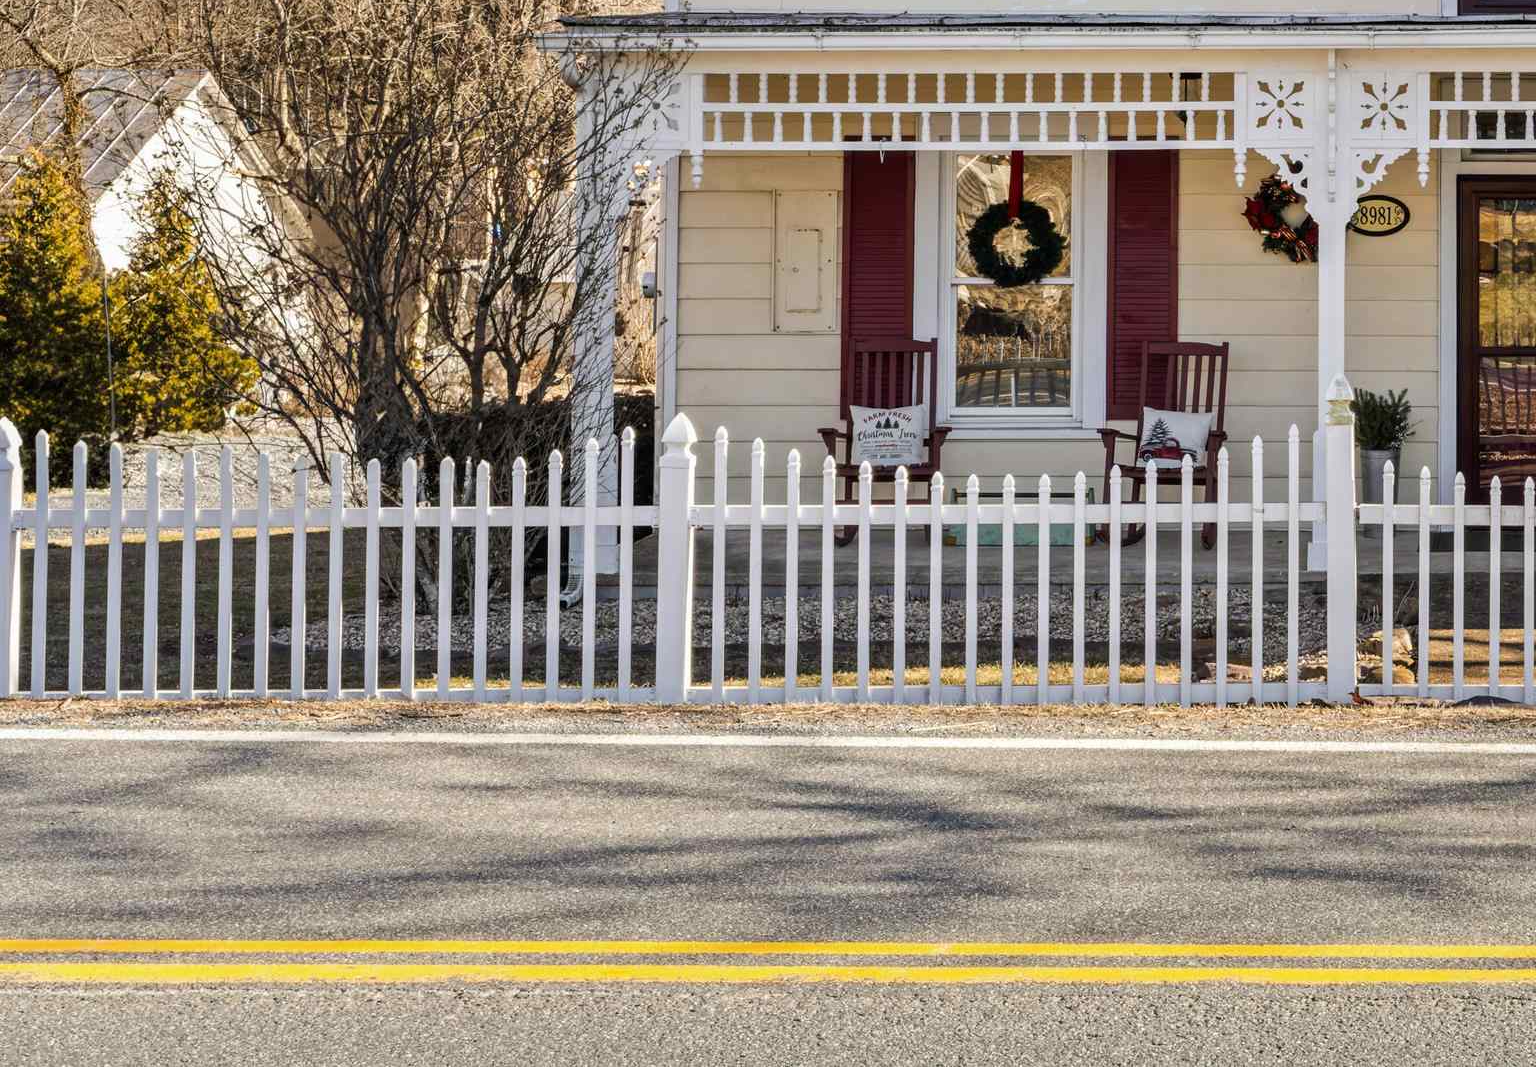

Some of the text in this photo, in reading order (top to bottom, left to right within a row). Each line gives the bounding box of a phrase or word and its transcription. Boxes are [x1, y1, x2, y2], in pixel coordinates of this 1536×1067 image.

[1360, 205, 1391, 225] 8981
[863, 411, 912, 423] FARM FRESH
[857, 430, 895, 441] Christmas
